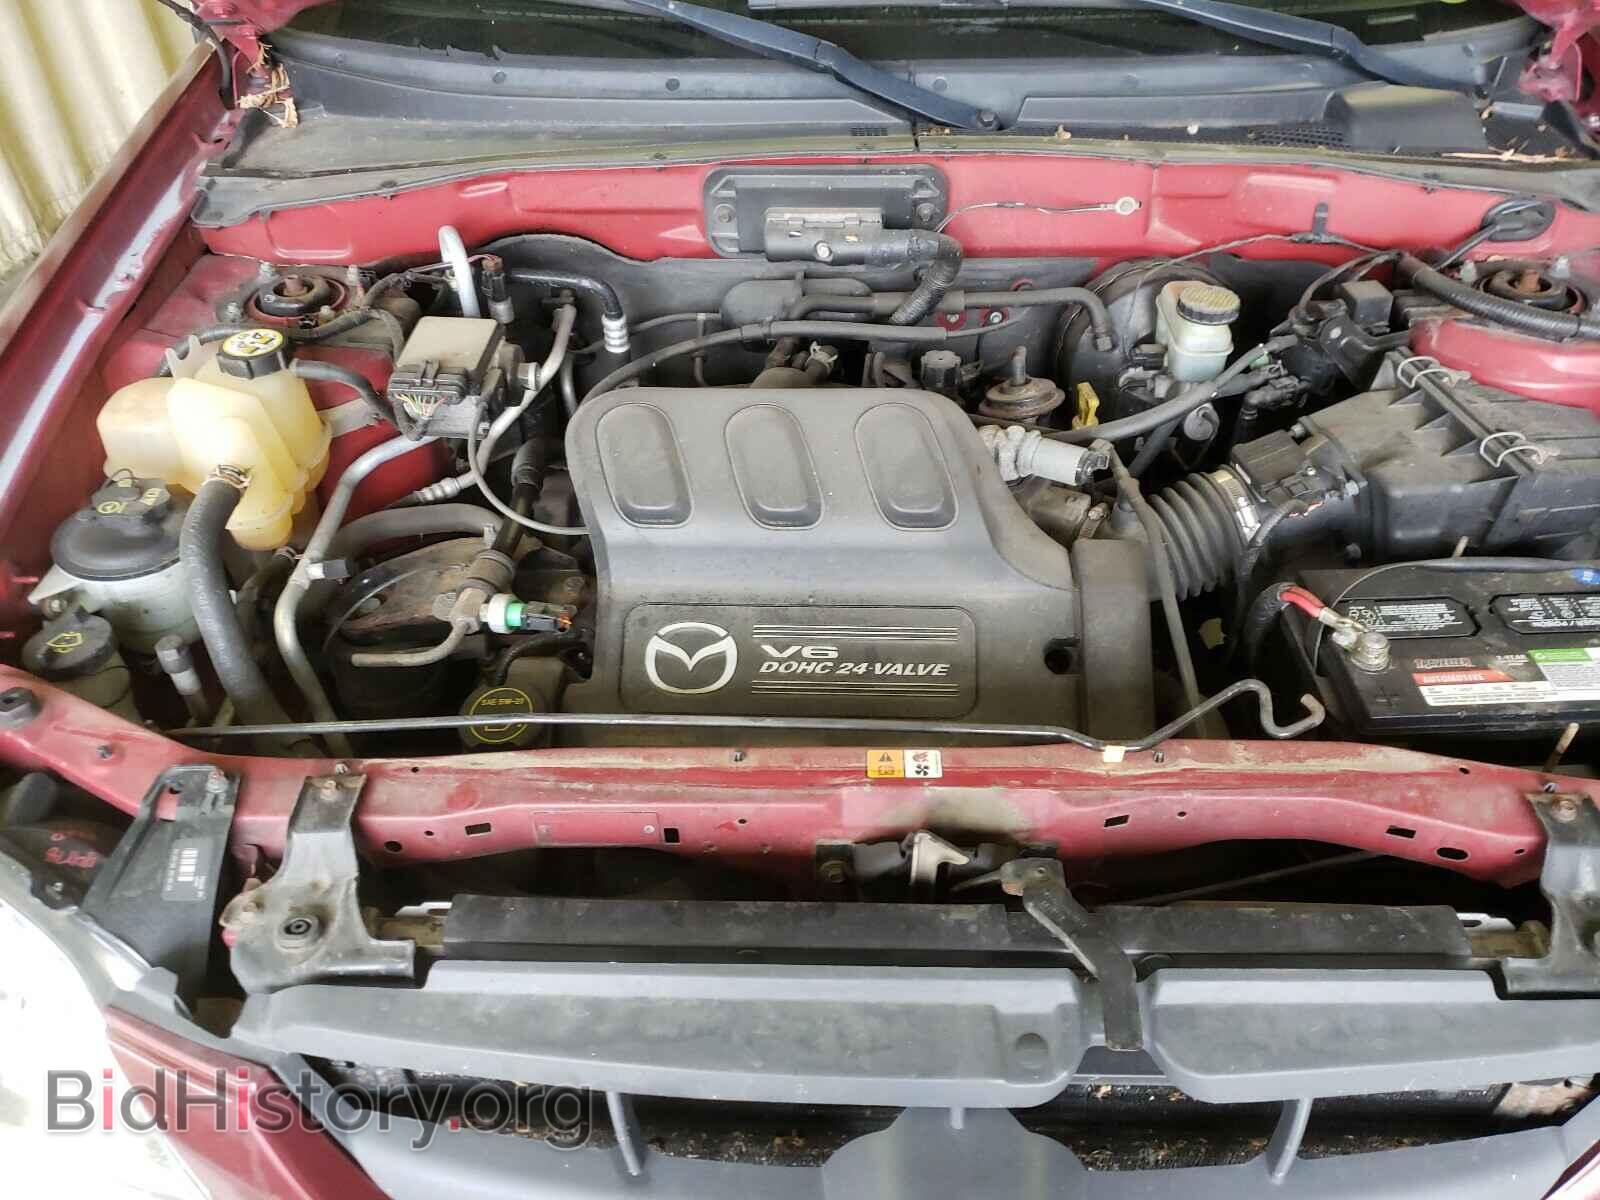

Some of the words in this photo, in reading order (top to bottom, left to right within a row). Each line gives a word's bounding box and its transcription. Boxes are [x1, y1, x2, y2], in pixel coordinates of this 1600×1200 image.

[760, 645, 839, 659] V6
[759, 661, 834, 675] DOHC
[834, 661, 951, 677] 24-VALVE
